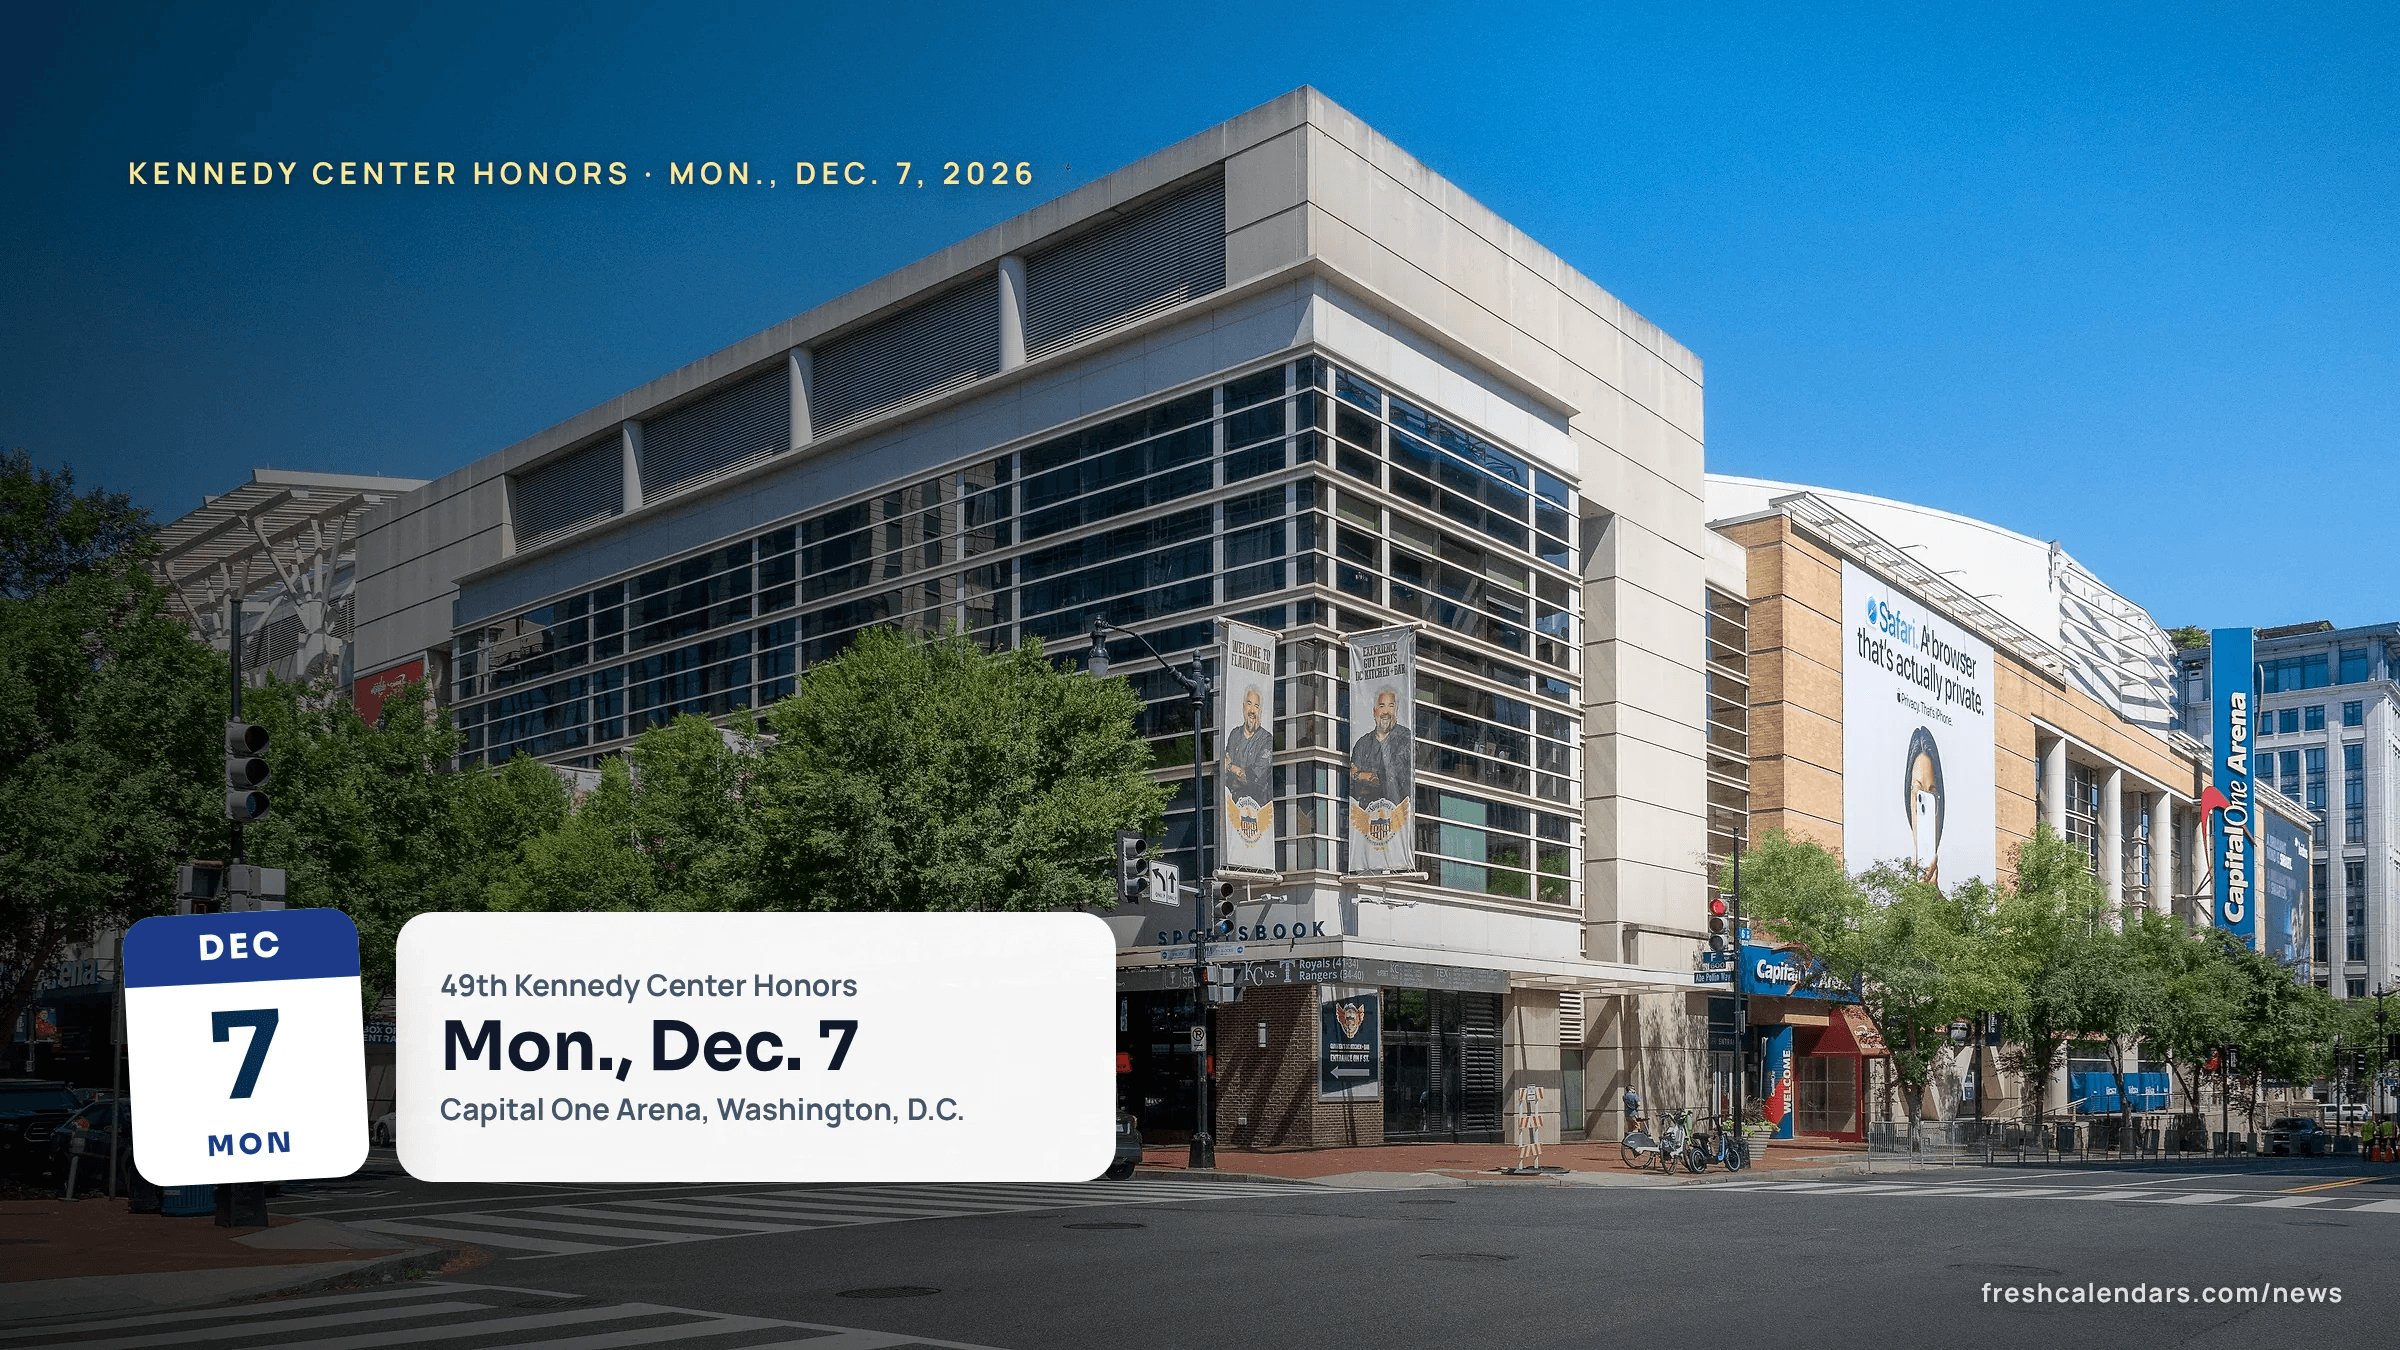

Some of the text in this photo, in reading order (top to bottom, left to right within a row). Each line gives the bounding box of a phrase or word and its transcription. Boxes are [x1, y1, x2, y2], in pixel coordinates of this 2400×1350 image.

[1232, 640, 1271, 662] WELCOME TO
[1362, 641, 1398, 657] EXPERIENCE
[1880, 601, 1977, 680] Safari. A browser
[1231, 653, 1271, 676] FLAVORTOWN
[1363, 656, 1376, 669] GUY
[1857, 626, 1985, 717] that's actually private.
[2226, 691, 2248, 776] Arena
[1158, 920, 1325, 946] SPOSBOOK
[1299, 958, 1331, 972] Royals
[1710, 952, 1717, 962] F
[1264, 969, 1278, 979] vs.
[1299, 969, 1338, 983] Rangers
[1782, 1049, 1792, 1115] WELCOME
